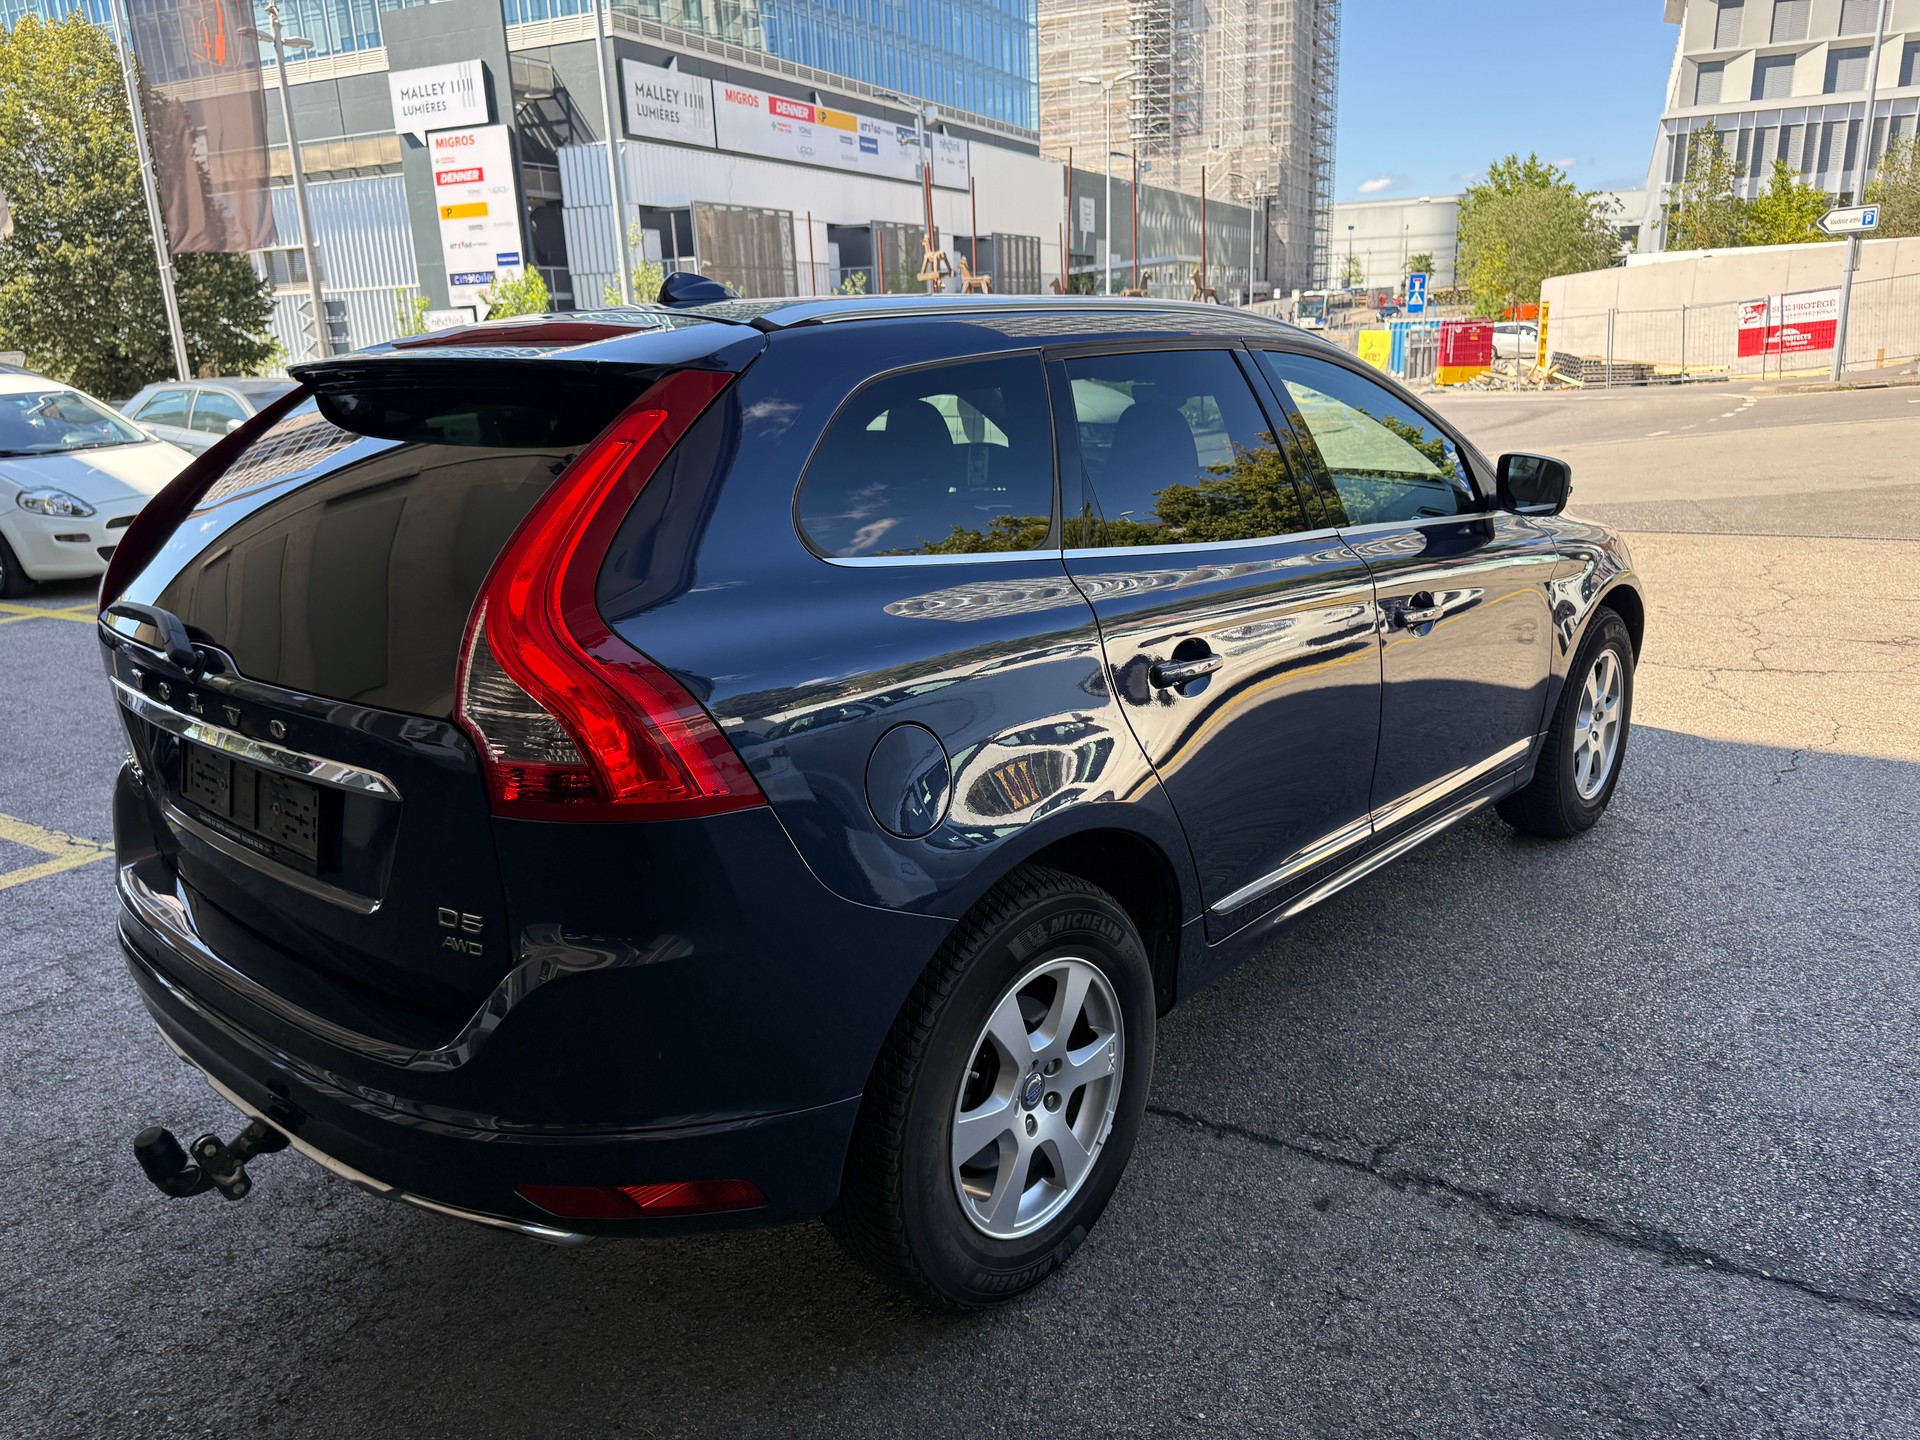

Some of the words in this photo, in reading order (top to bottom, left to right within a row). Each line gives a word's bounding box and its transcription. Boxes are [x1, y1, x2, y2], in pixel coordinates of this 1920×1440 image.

[400, 81, 445, 101] MALLEY
[634, 81, 679, 105] MALLEY
[725, 87, 760, 108] MIGROS
[402, 100, 447, 116] LUMIÈRES
[636, 103, 680, 124] LUMIÈRES
[775, 100, 809, 119] DENNER
[435, 134, 475, 149] MIGROS
[440, 170, 480, 184] DENNER
[1865, 215, 1872, 224] P
[131, 668, 288, 740] VOLVO
[438, 906, 483, 934] D5
[1050, 913, 1122, 941] MICHELIN
[441, 936, 483, 956] AWD
